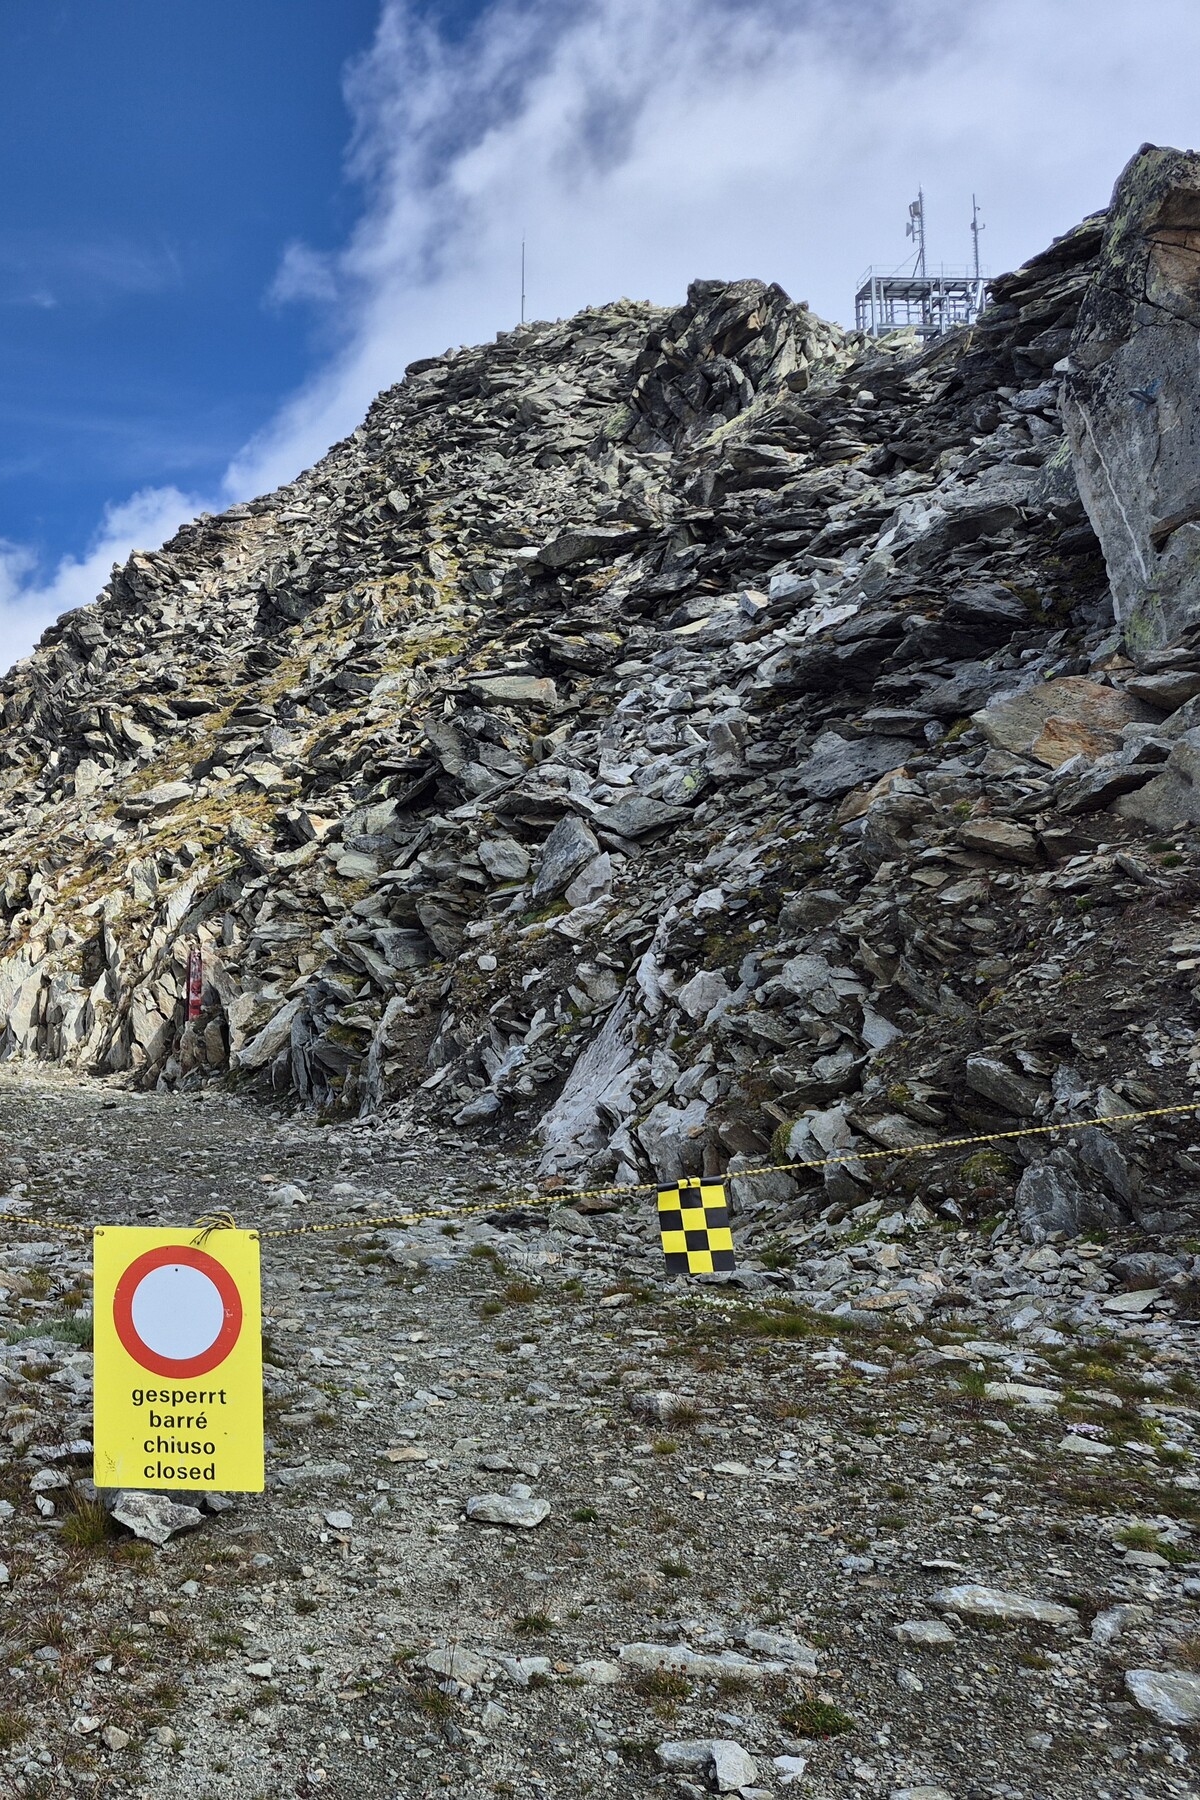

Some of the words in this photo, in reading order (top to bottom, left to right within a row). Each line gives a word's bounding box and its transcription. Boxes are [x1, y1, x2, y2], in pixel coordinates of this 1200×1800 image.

[131, 1388, 227, 1407] gesperrt
[149, 1409, 208, 1430] barré
[143, 1435, 216, 1455] chiuso
[143, 1460, 216, 1481] closed
